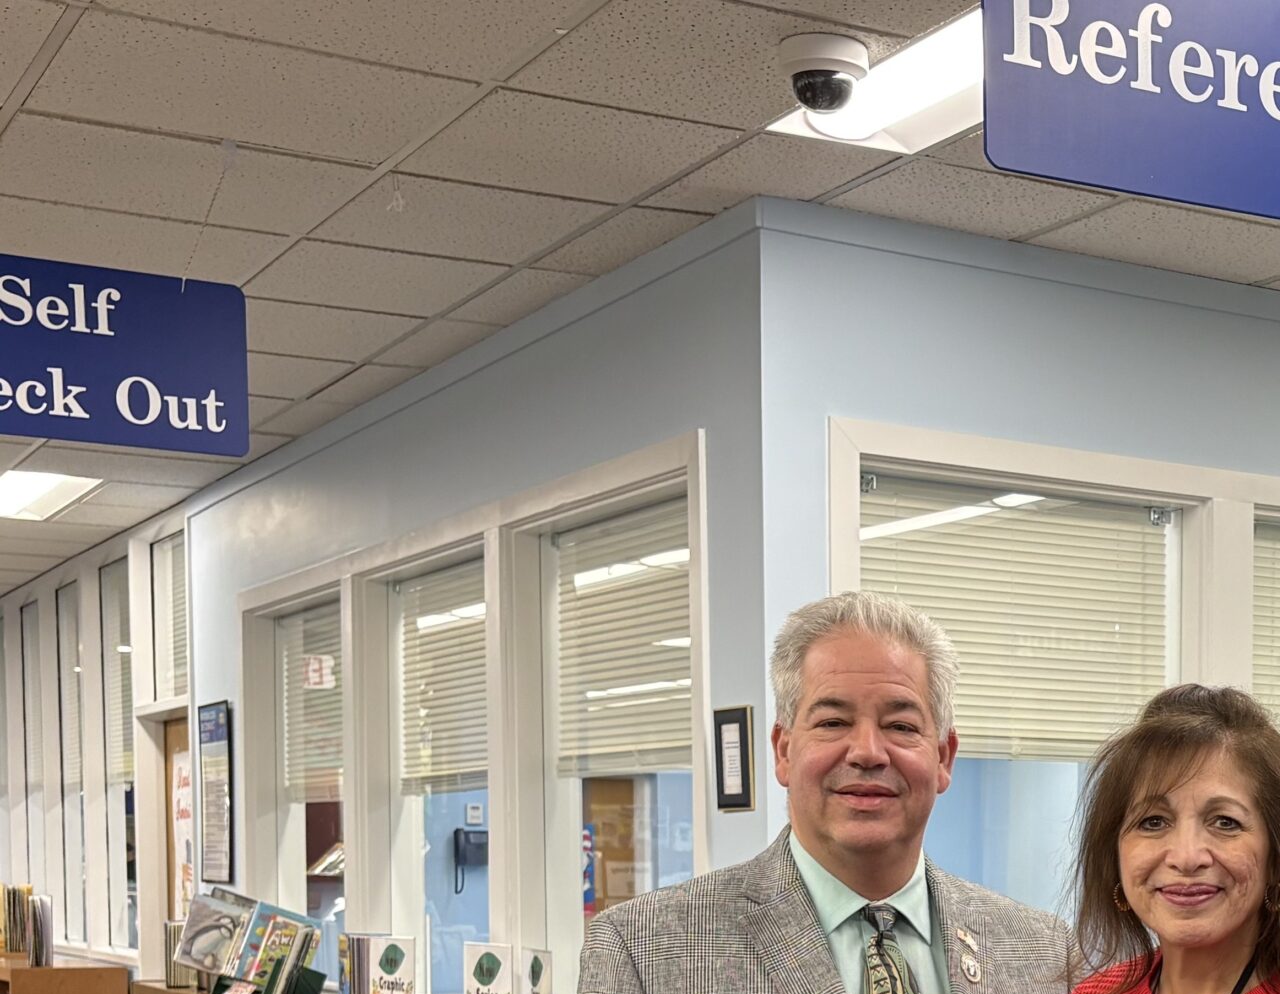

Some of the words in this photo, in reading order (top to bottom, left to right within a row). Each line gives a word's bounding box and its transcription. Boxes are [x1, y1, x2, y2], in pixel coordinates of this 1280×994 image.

[0, 274, 121, 336] Self
[116, 376, 227, 433] Out
[379, 976, 405, 994] Graphic
